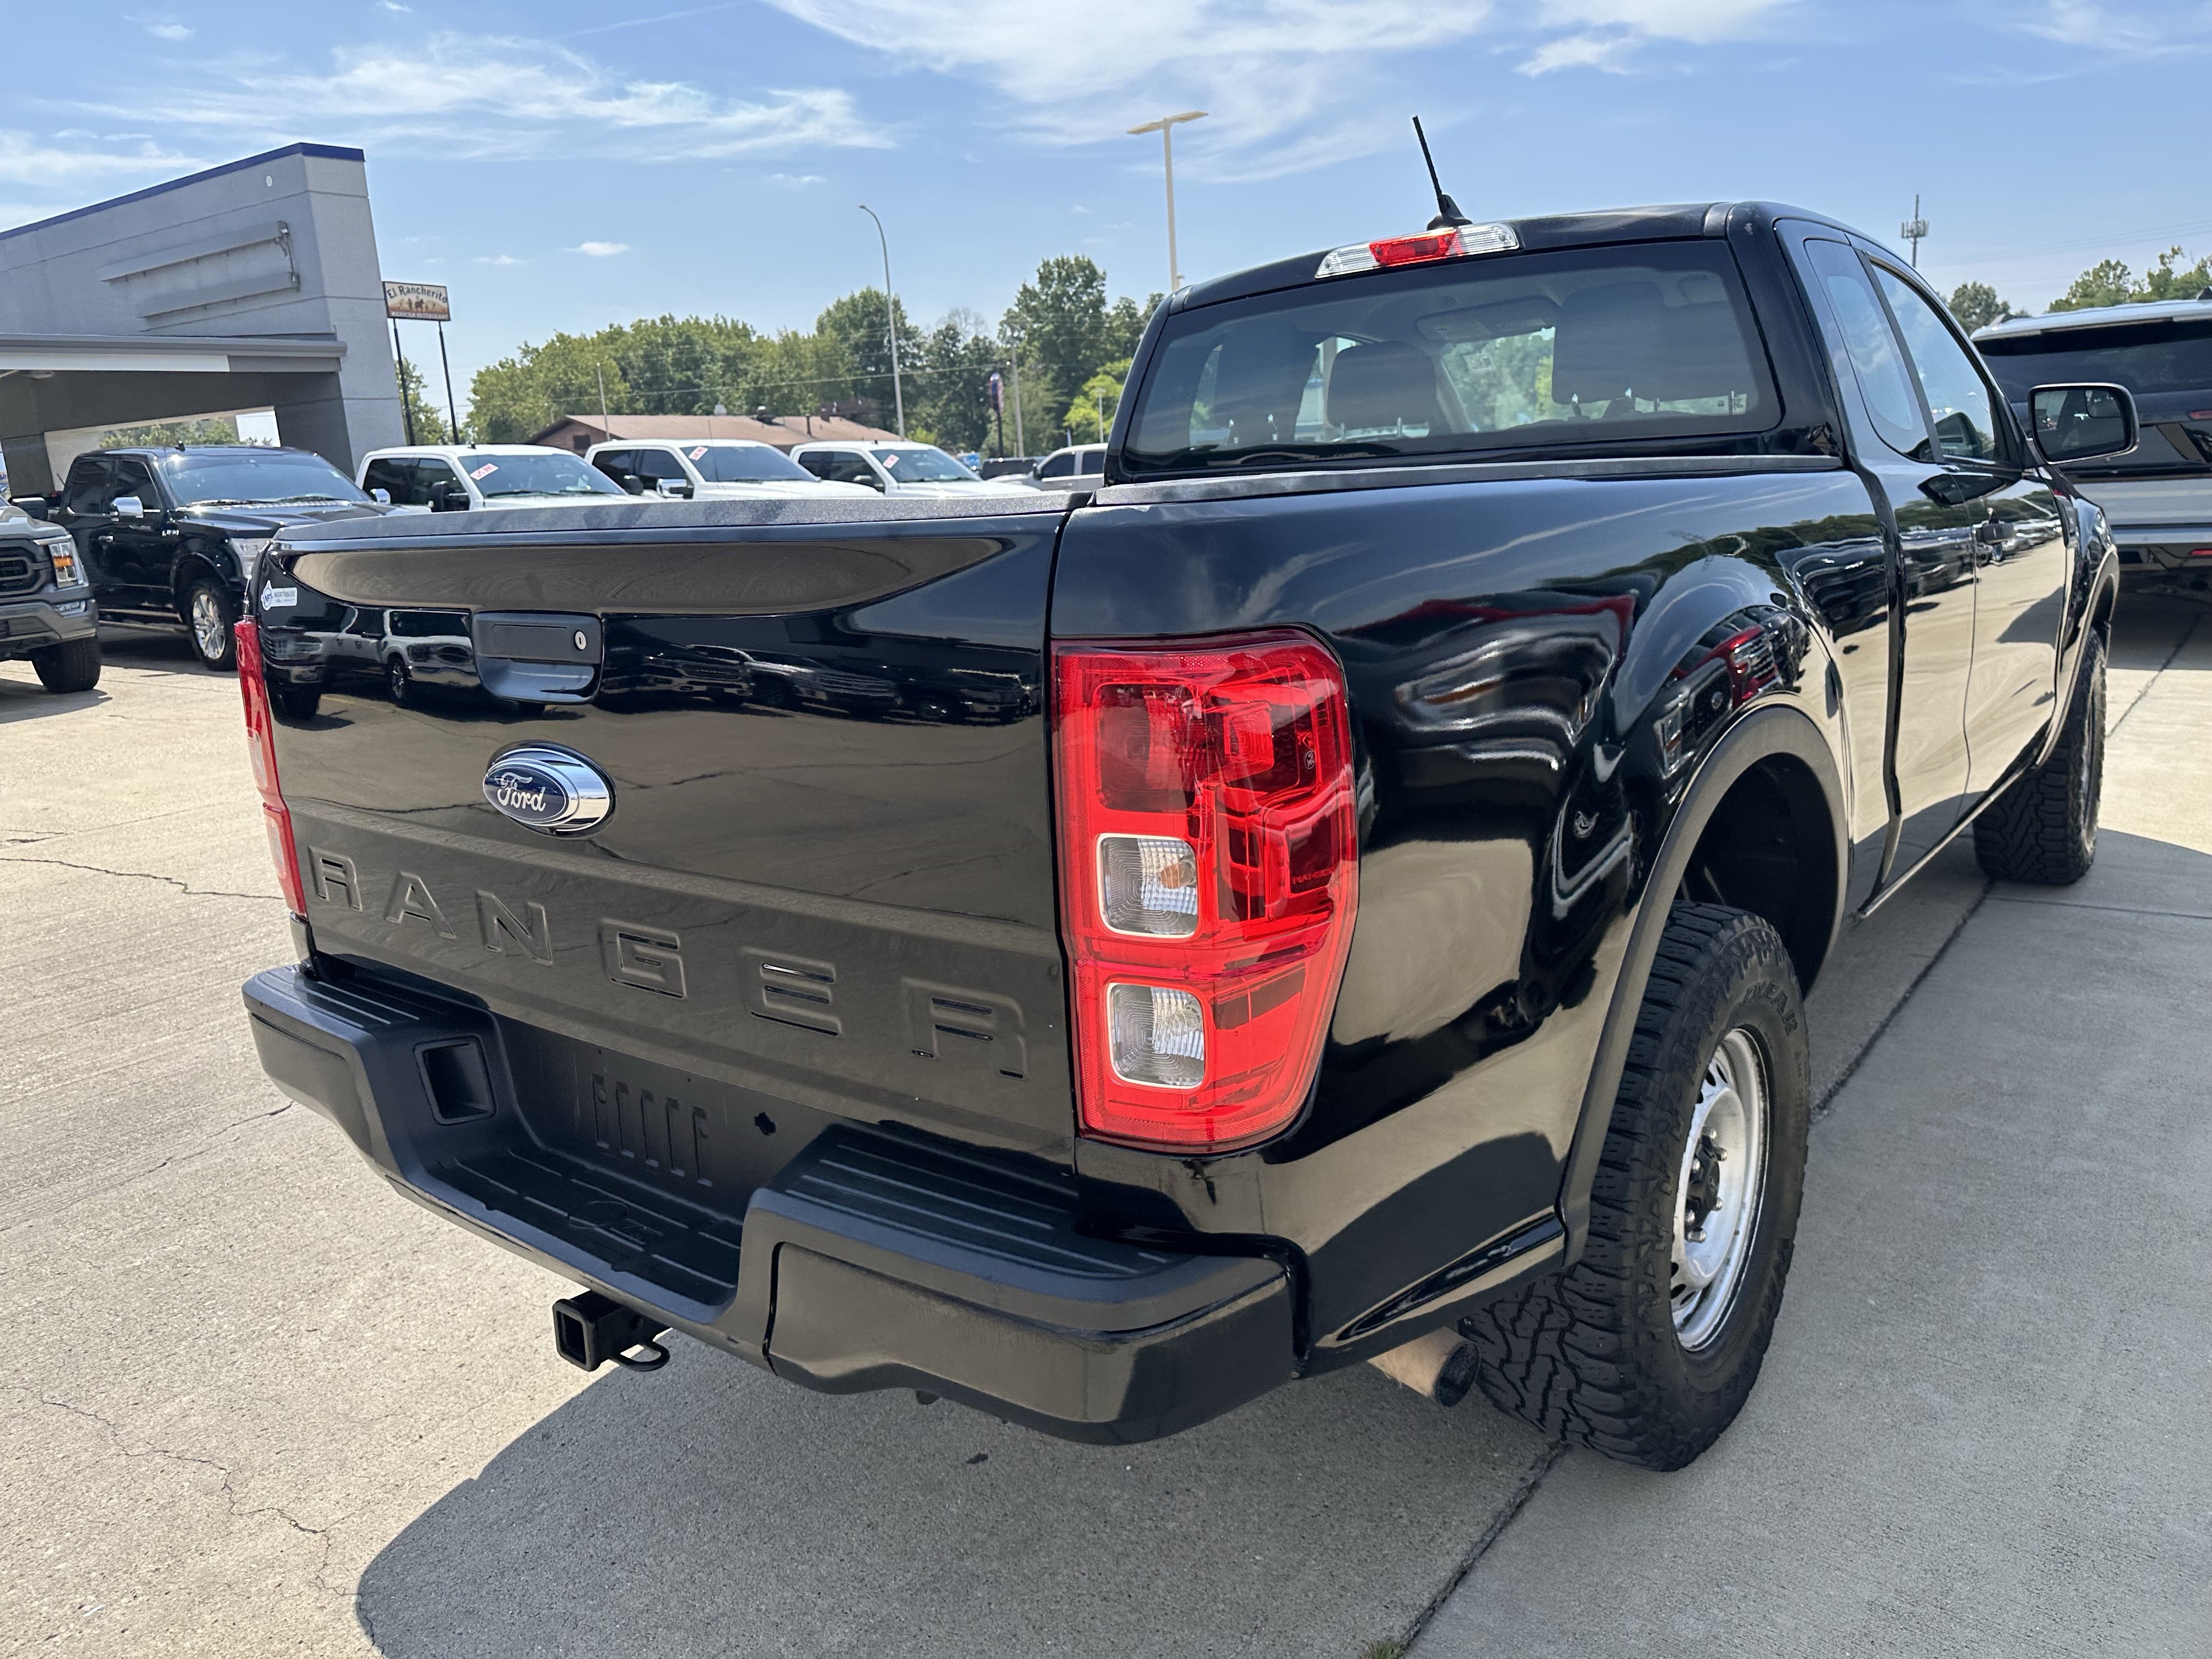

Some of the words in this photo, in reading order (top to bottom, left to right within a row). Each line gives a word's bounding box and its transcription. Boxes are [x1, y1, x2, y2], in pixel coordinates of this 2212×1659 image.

[387, 288, 397, 299] El
[398, 286, 448, 303] Rancherito
[495, 772, 546, 812] Ford
[307, 845, 1029, 1081] RANGER
